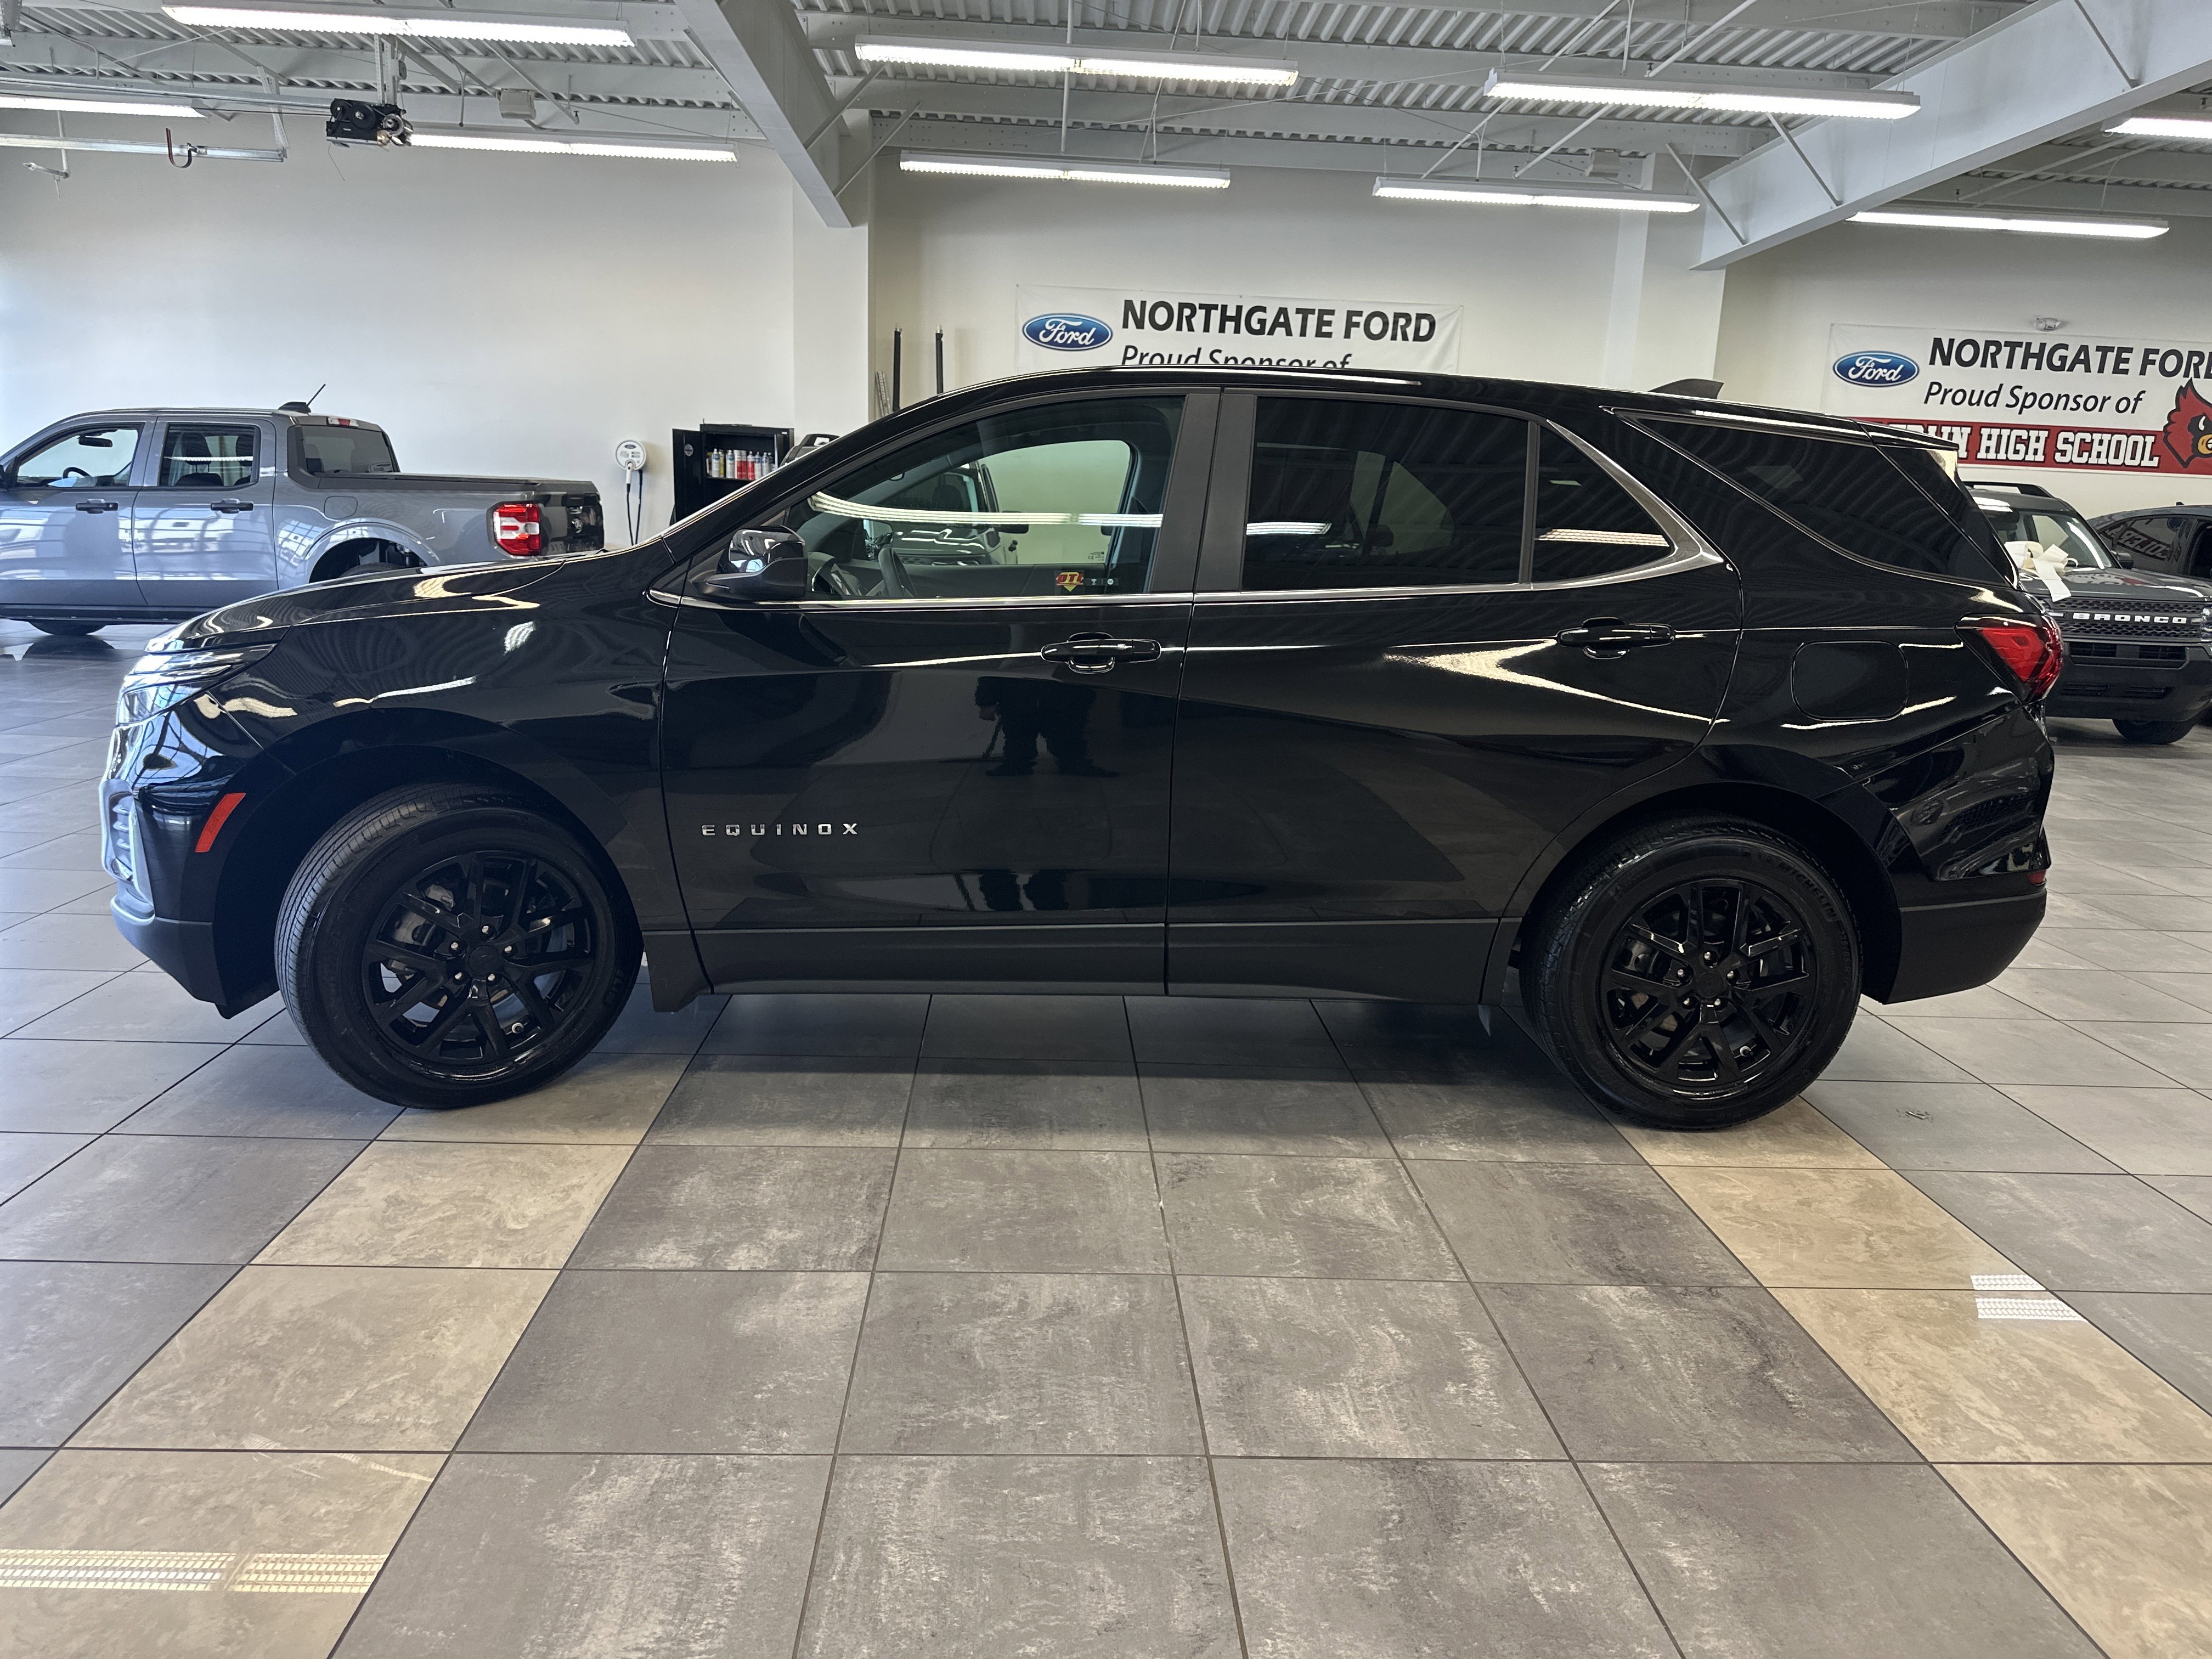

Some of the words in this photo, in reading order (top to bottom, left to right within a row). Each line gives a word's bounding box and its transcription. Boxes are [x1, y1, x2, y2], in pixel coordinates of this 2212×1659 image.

[1039, 319, 1096, 345] Ford
[1122, 299, 1335, 338] NORTHGATE
[1344, 310, 1436, 342] FORD
[1121, 345, 1202, 365] Proud
[1848, 356, 1904, 381] Ford
[1928, 337, 2134, 375] NORTHGATE
[1923, 381, 2004, 407] Proud
[2005, 385, 2112, 415] Sponsor
[2115, 390, 2146, 414] of
[1977, 428, 2049, 461] HIGH
[2055, 432, 2159, 467] SCHOOL
[2073, 612, 2187, 624] BRONCO
[702, 823, 857, 836] EQUINOX
[1776, 861, 1837, 918] MICHELIN
